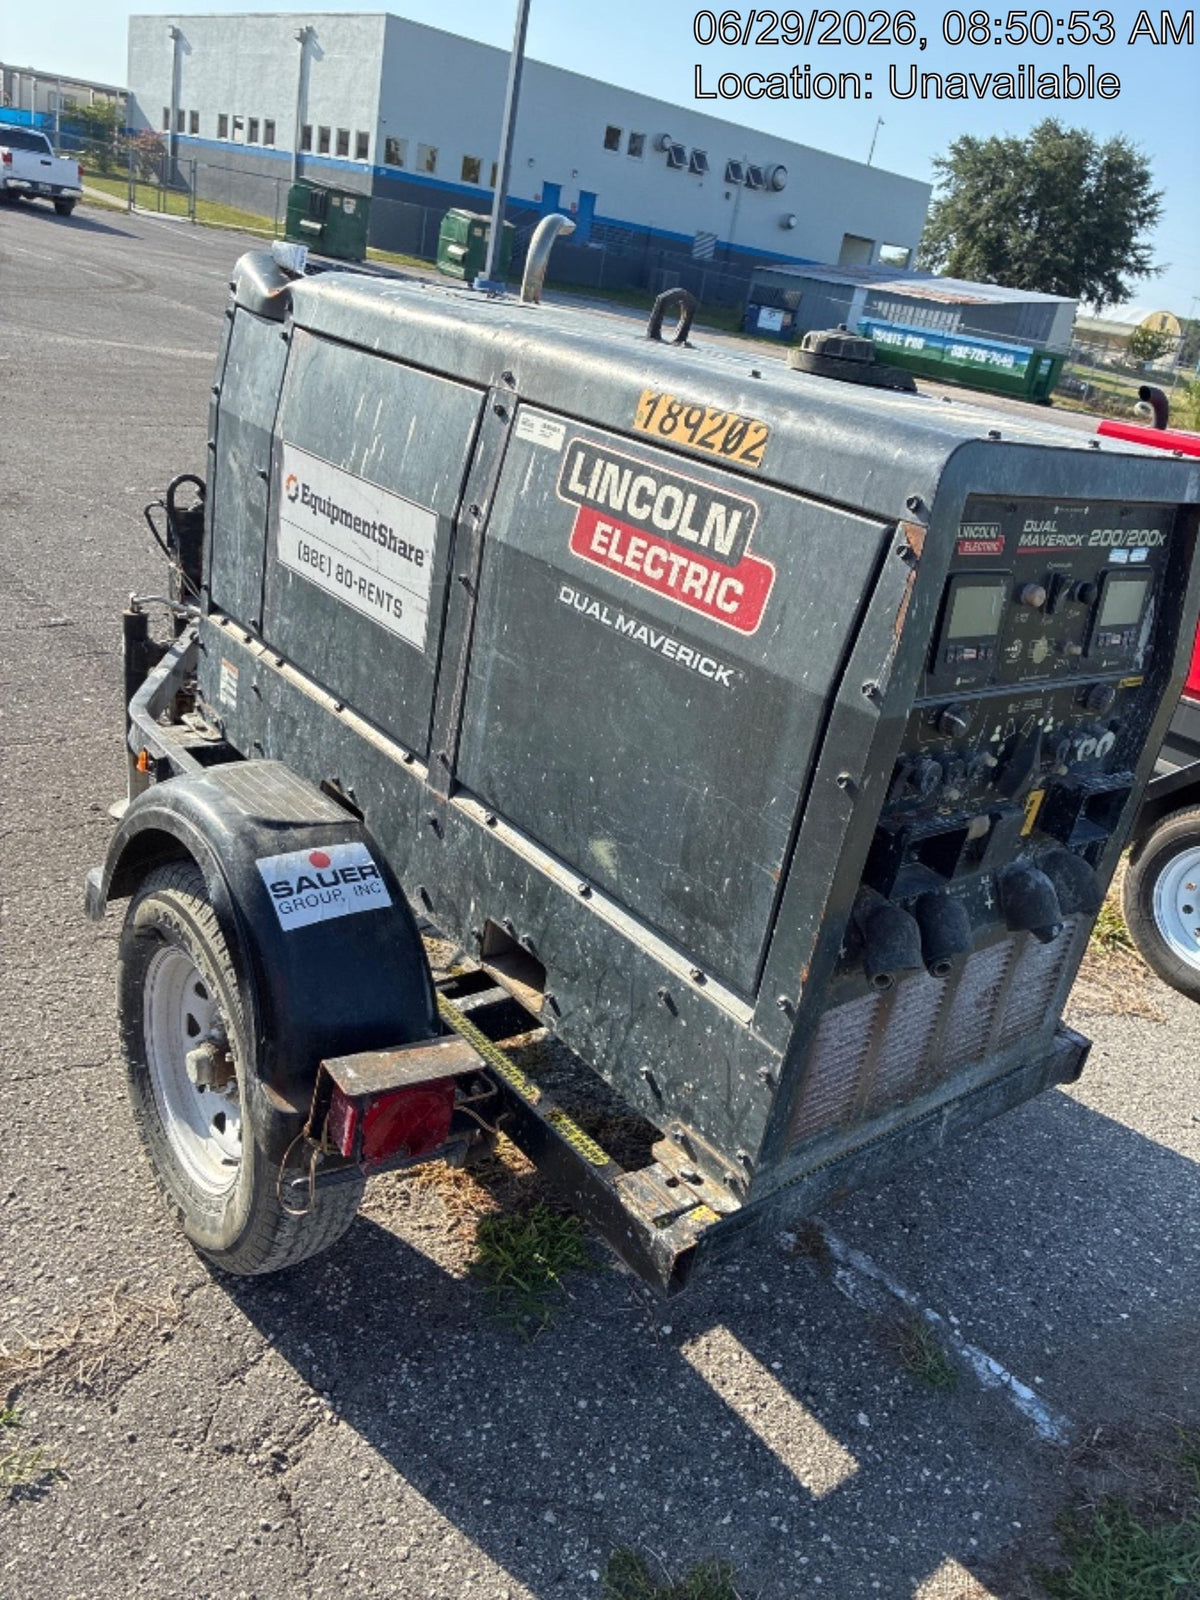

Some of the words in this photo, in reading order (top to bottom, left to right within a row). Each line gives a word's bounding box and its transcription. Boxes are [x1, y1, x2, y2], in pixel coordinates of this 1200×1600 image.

[643, 393, 770, 464] 189202
[301, 483, 424, 568] EquipmentShare
[568, 451, 742, 555] LINCOLN
[1022, 520, 1058, 532] DUAL
[589, 520, 744, 614] ELECTRIC
[964, 541, 999, 552] ELECTRIC
[1018, 533, 1083, 547] MAVERICK
[335, 563, 403, 620] 80-RENTS
[558, 585, 612, 625] DUAL
[614, 615, 735, 686] MAVERICK
[270, 864, 380, 899] SAUER
[278, 888, 346, 915] GROUP,
[353, 881, 382, 897] INC
